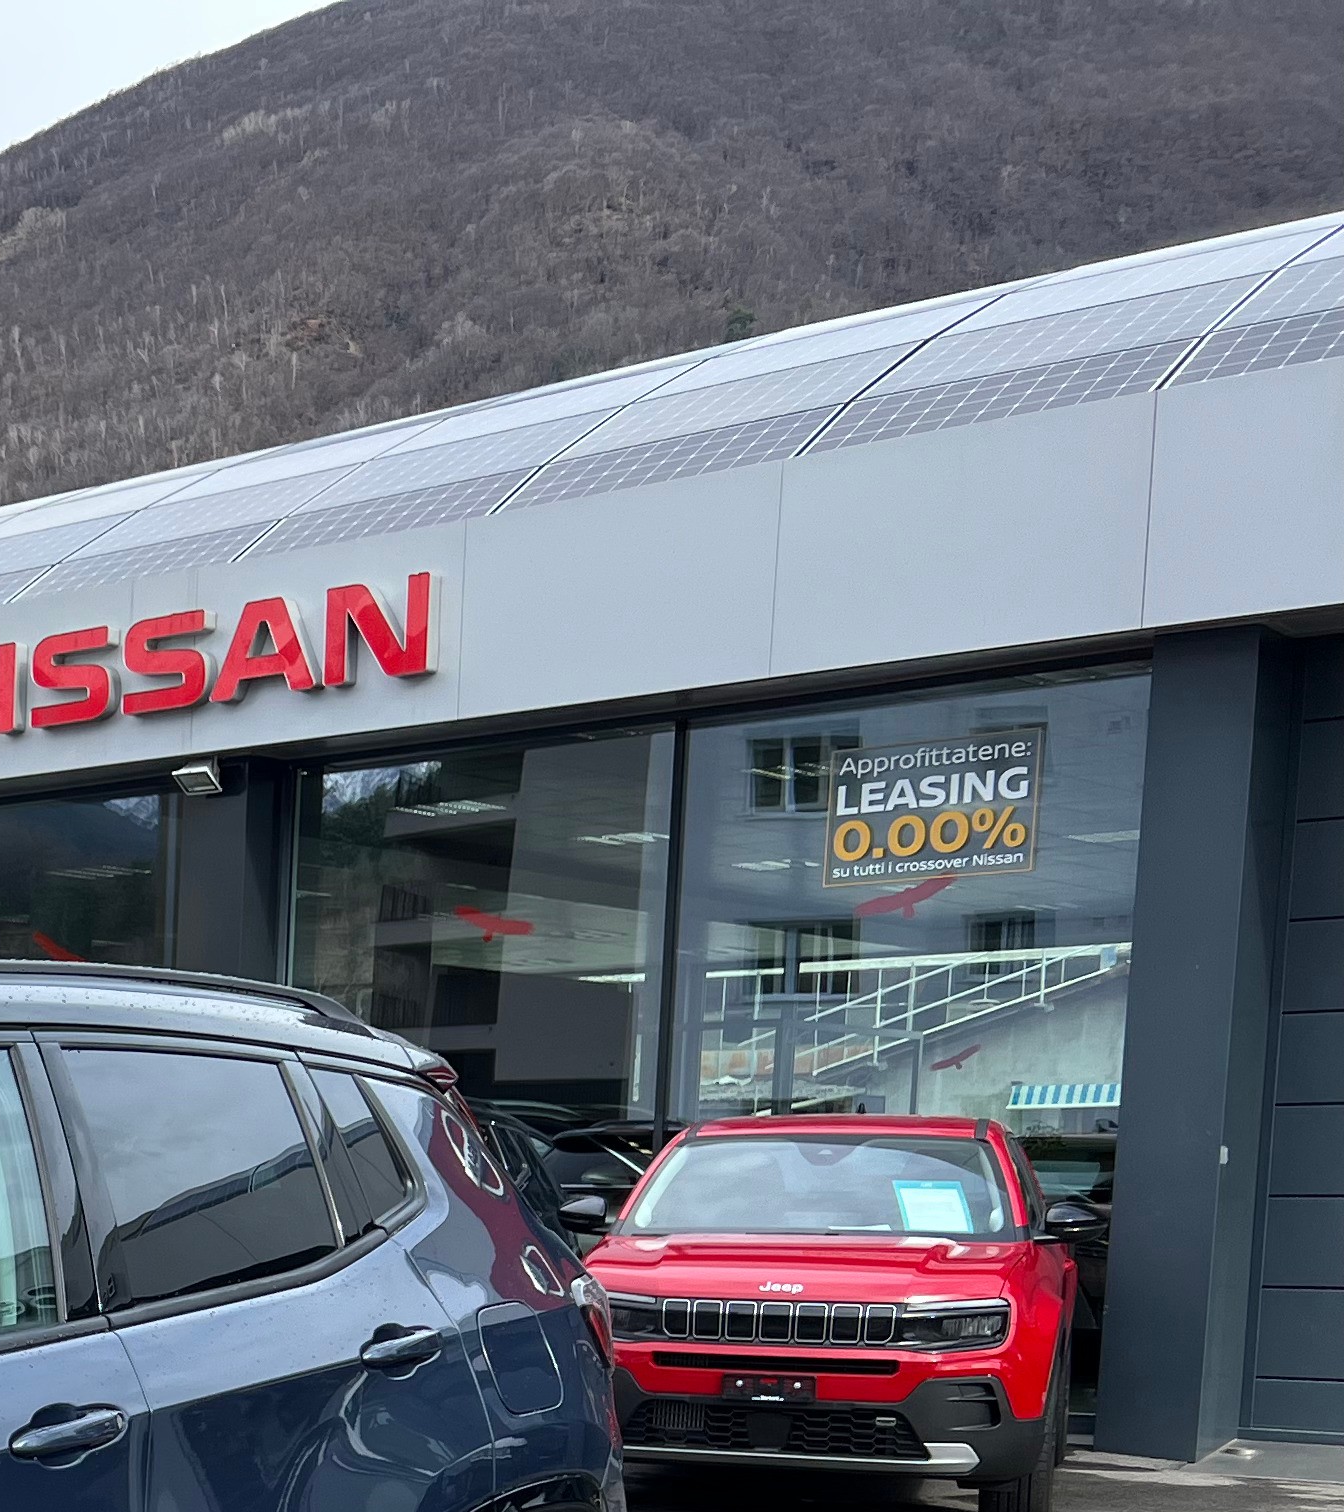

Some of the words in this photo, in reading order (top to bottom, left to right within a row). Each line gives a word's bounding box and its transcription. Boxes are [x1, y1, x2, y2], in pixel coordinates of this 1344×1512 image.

[839, 741, 1032, 778] Approfittatene:
[836, 767, 1029, 816] LEASING
[833, 806, 1026, 862] 0.00%
[832, 866, 850, 879] su
[853, 861, 884, 876] tutti
[895, 856, 968, 873] crossover
[972, 852, 1024, 867] Nissan
[758, 1281, 804, 1295] Jeep
